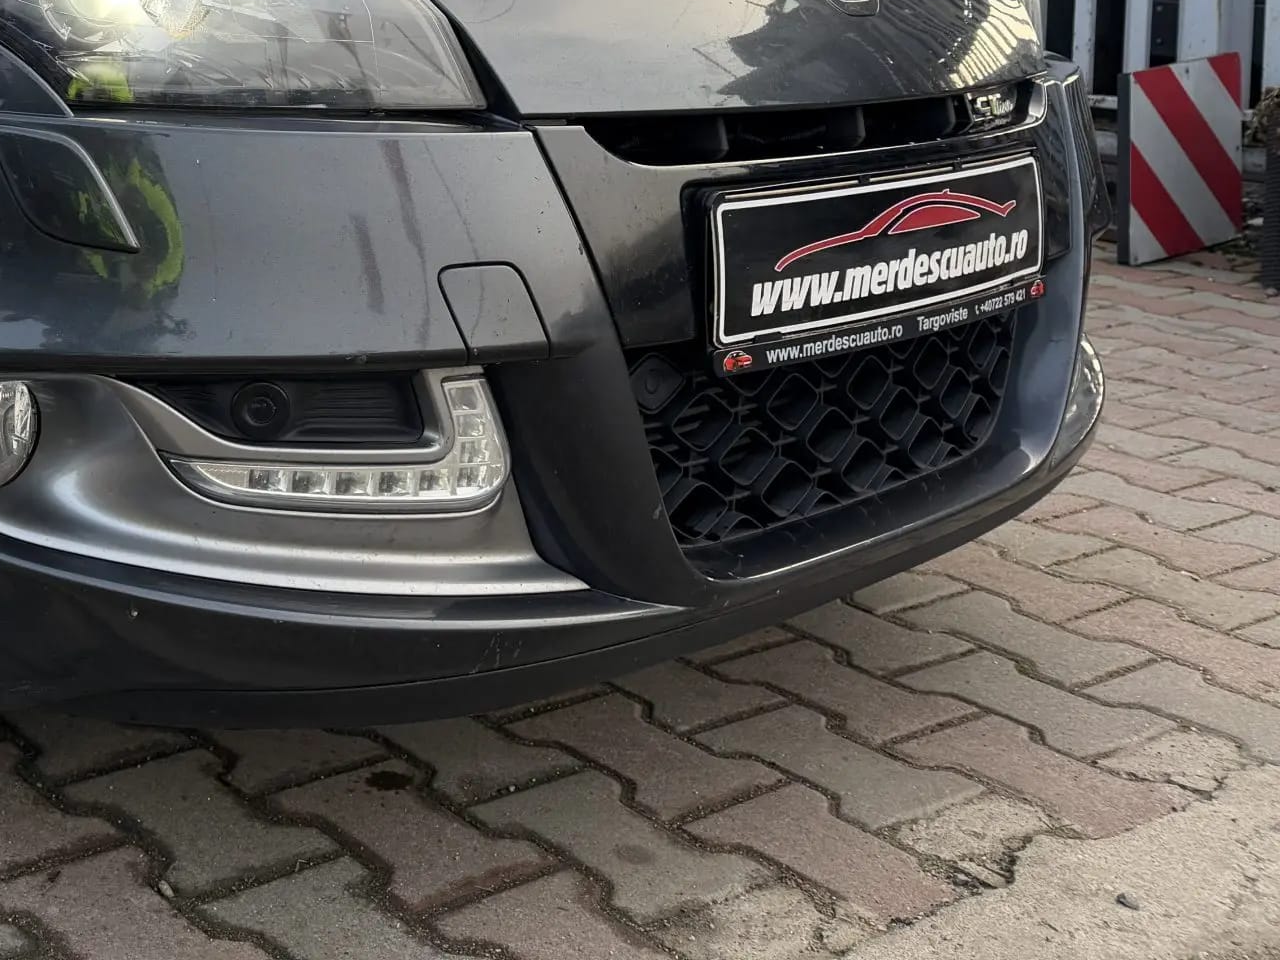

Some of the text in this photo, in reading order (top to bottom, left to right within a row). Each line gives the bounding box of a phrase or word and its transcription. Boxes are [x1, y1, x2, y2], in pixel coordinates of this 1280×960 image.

[750, 229, 1029, 317] www.merdescuauto.ro
[766, 323, 903, 364] www.merdescuauto.ro
[917, 306, 969, 332] Targoviste
[1003, 290, 1015, 306] 579
[1015, 287, 1027, 301] 421
